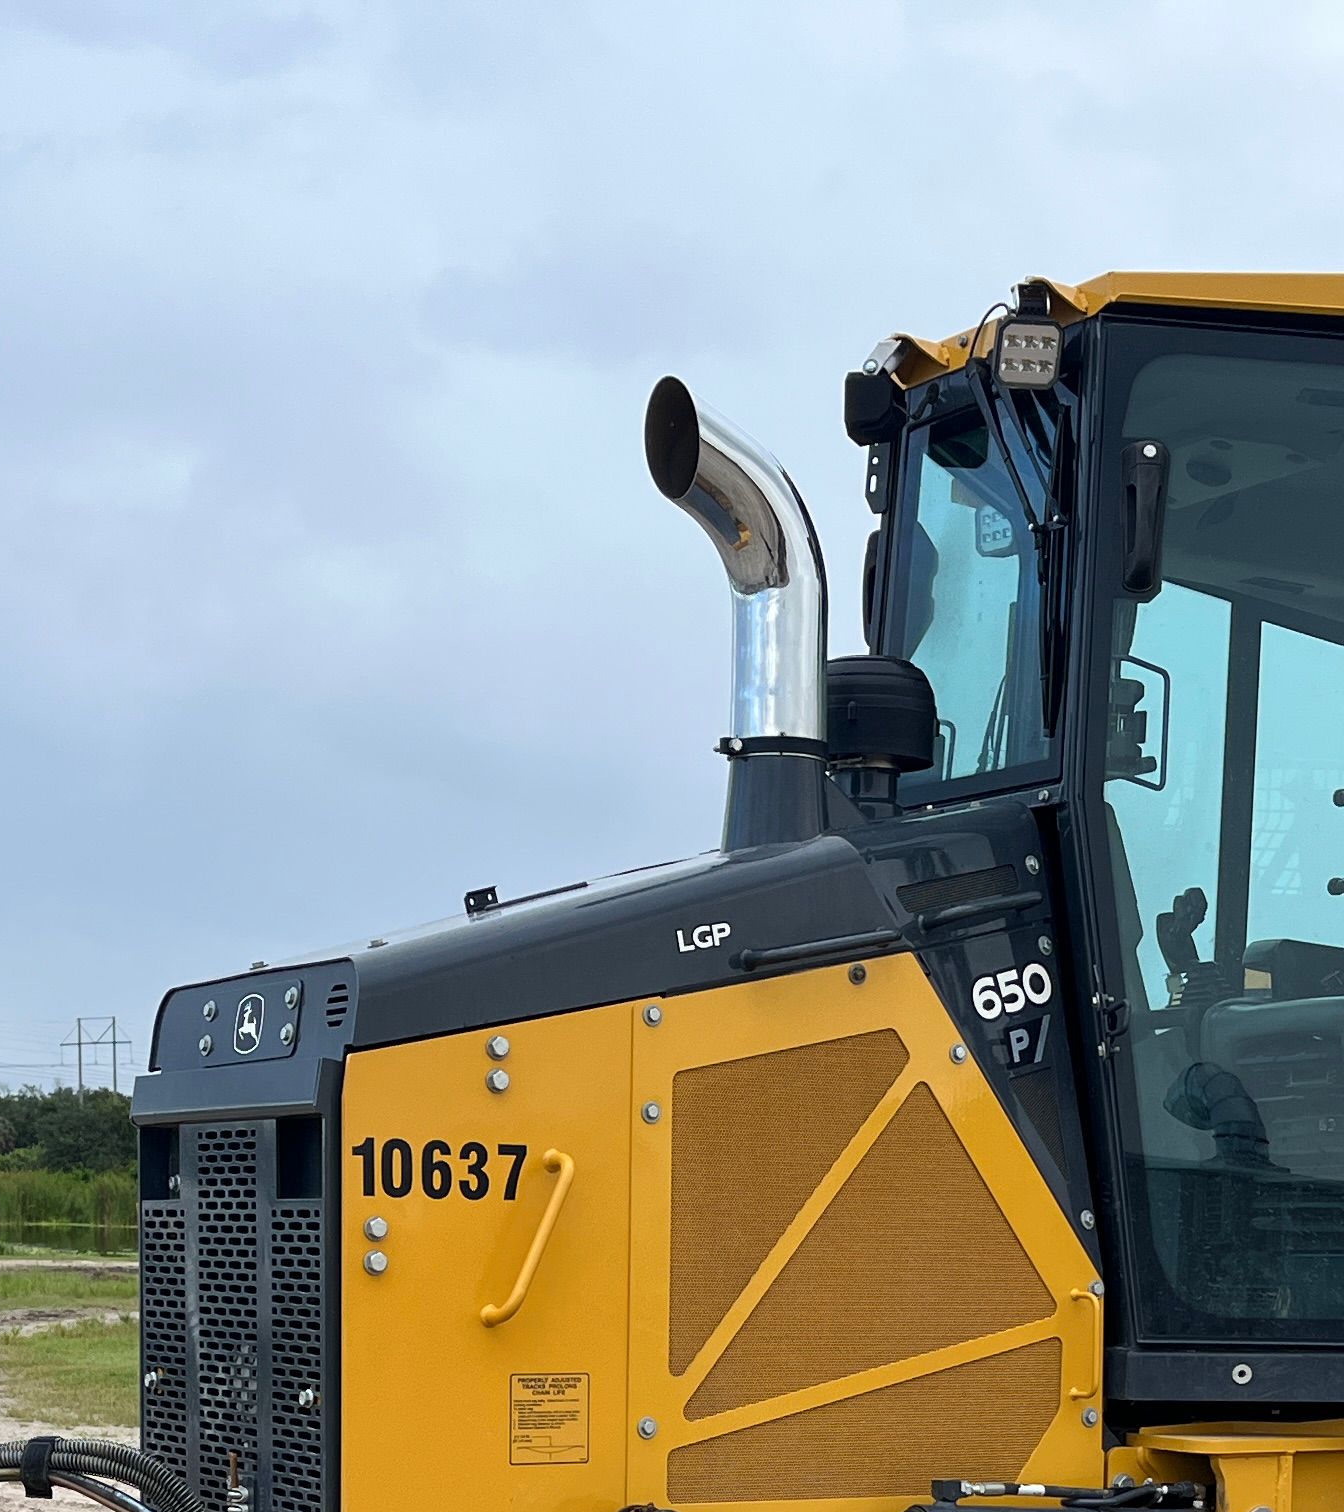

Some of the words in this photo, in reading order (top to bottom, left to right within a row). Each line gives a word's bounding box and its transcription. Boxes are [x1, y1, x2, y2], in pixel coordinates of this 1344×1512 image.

[676, 922, 731, 953] LGP
[972, 963, 1052, 1020] 650
[351, 1137, 528, 1201] 10637
